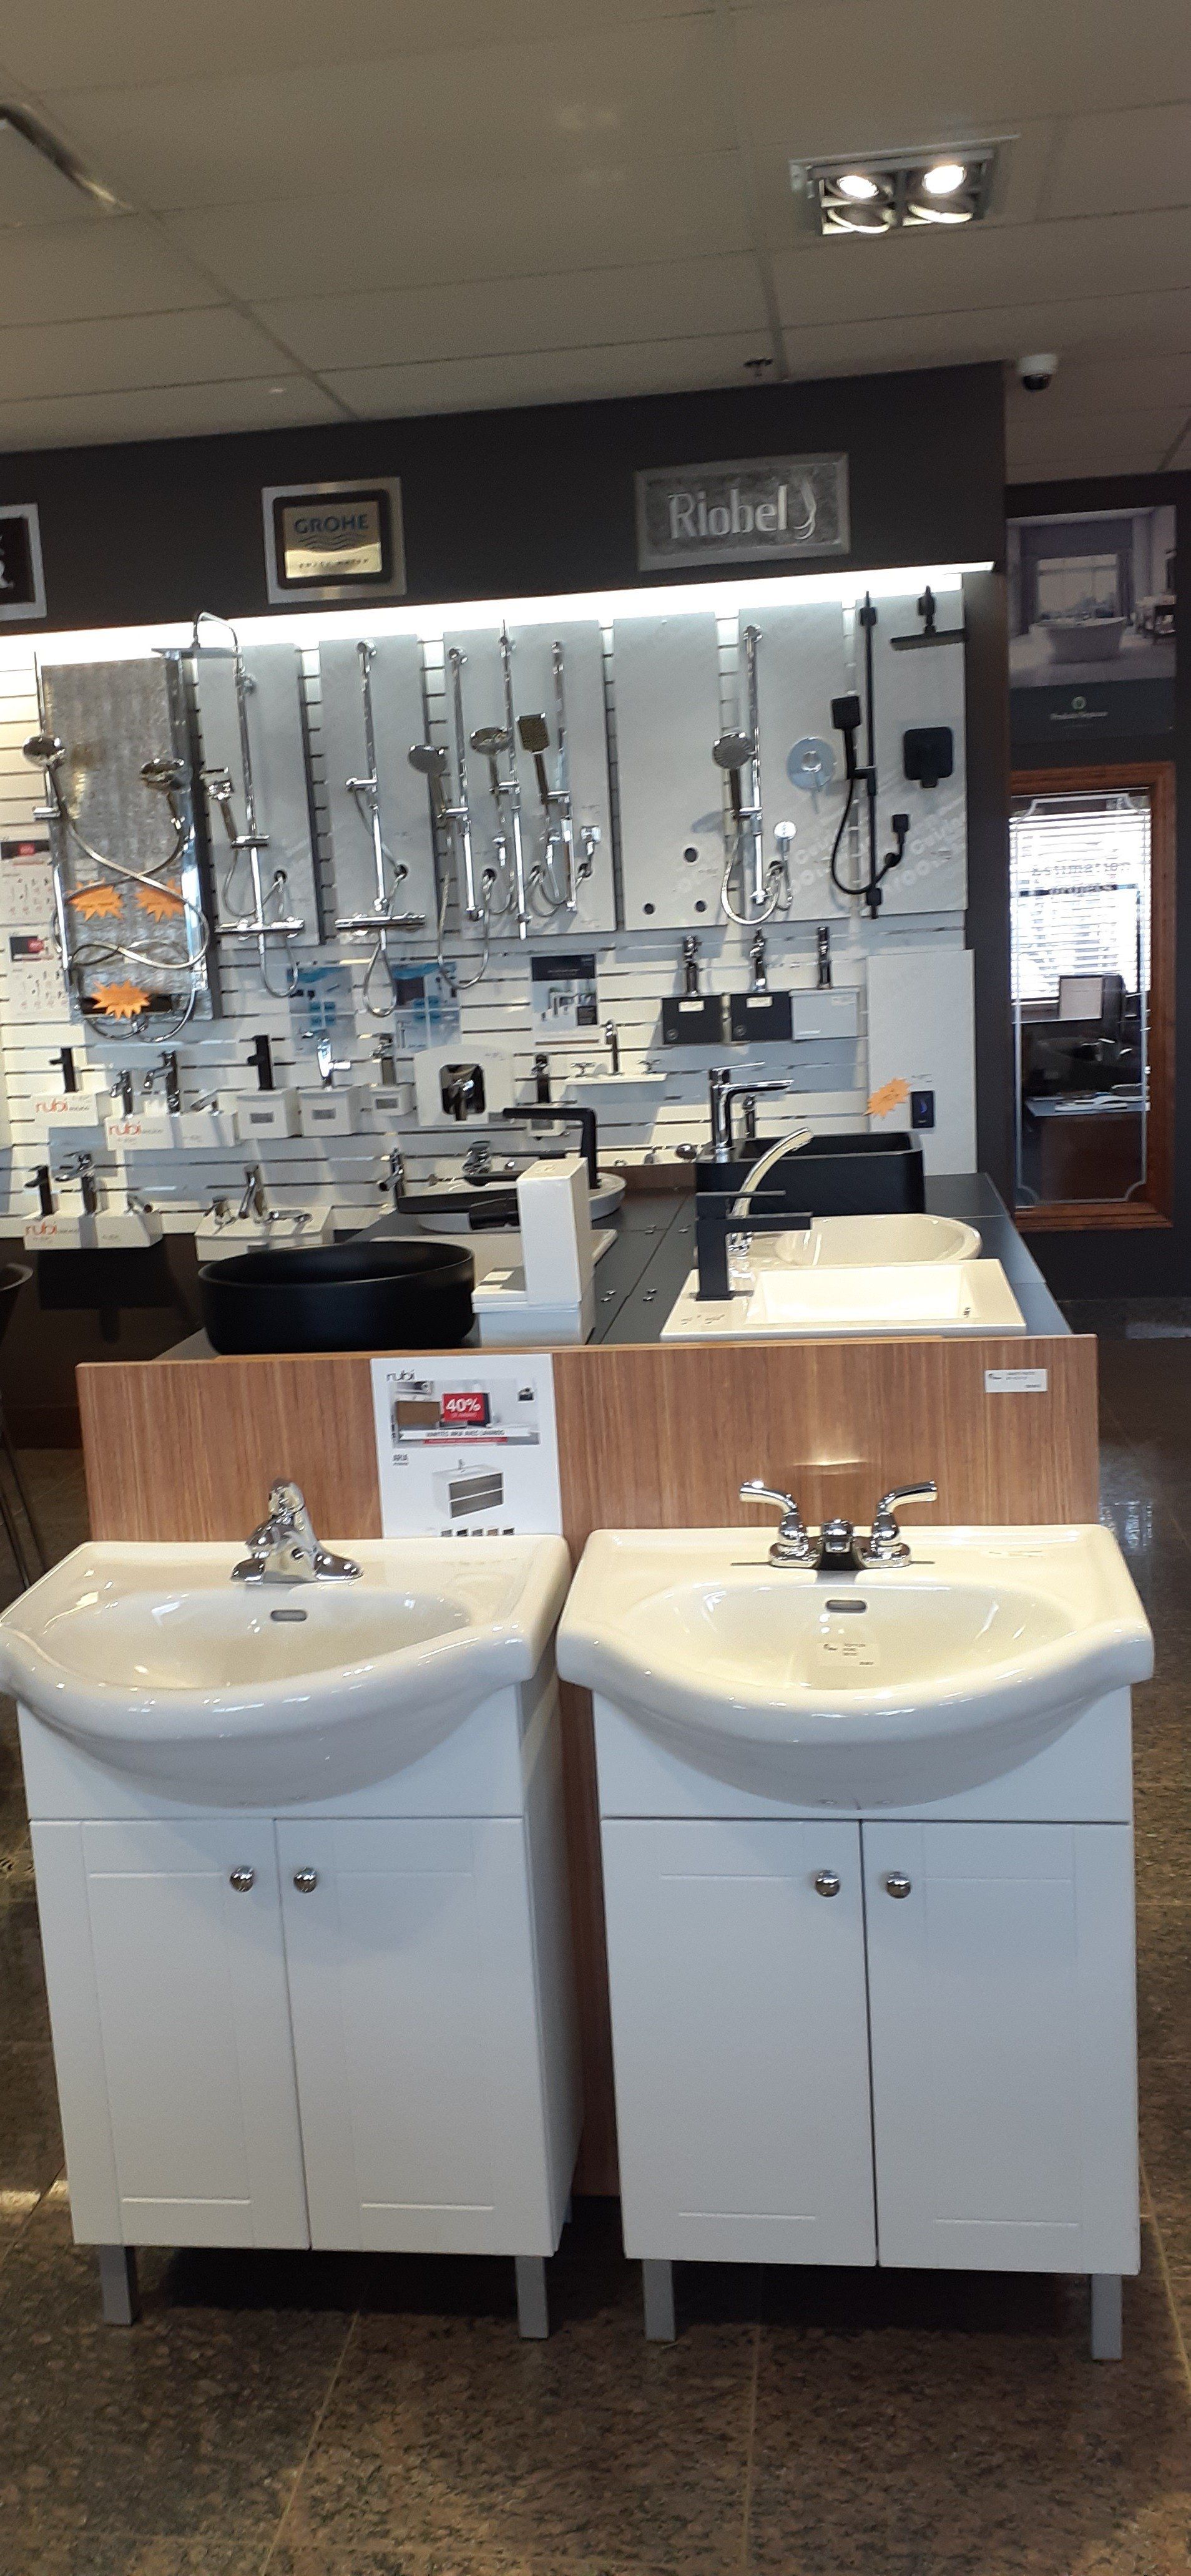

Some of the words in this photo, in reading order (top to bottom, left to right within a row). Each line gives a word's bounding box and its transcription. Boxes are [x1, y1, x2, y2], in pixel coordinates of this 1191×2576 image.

[667, 484, 788, 539] Riobel
[293, 514, 369, 534] GROHE
[35, 1097, 69, 1113] rubi
[109, 1121, 142, 1136] rubi
[24, 1221, 58, 1236] rubi
[386, 1368, 415, 1382] rubi
[446, 1397, 481, 1412] 40%
